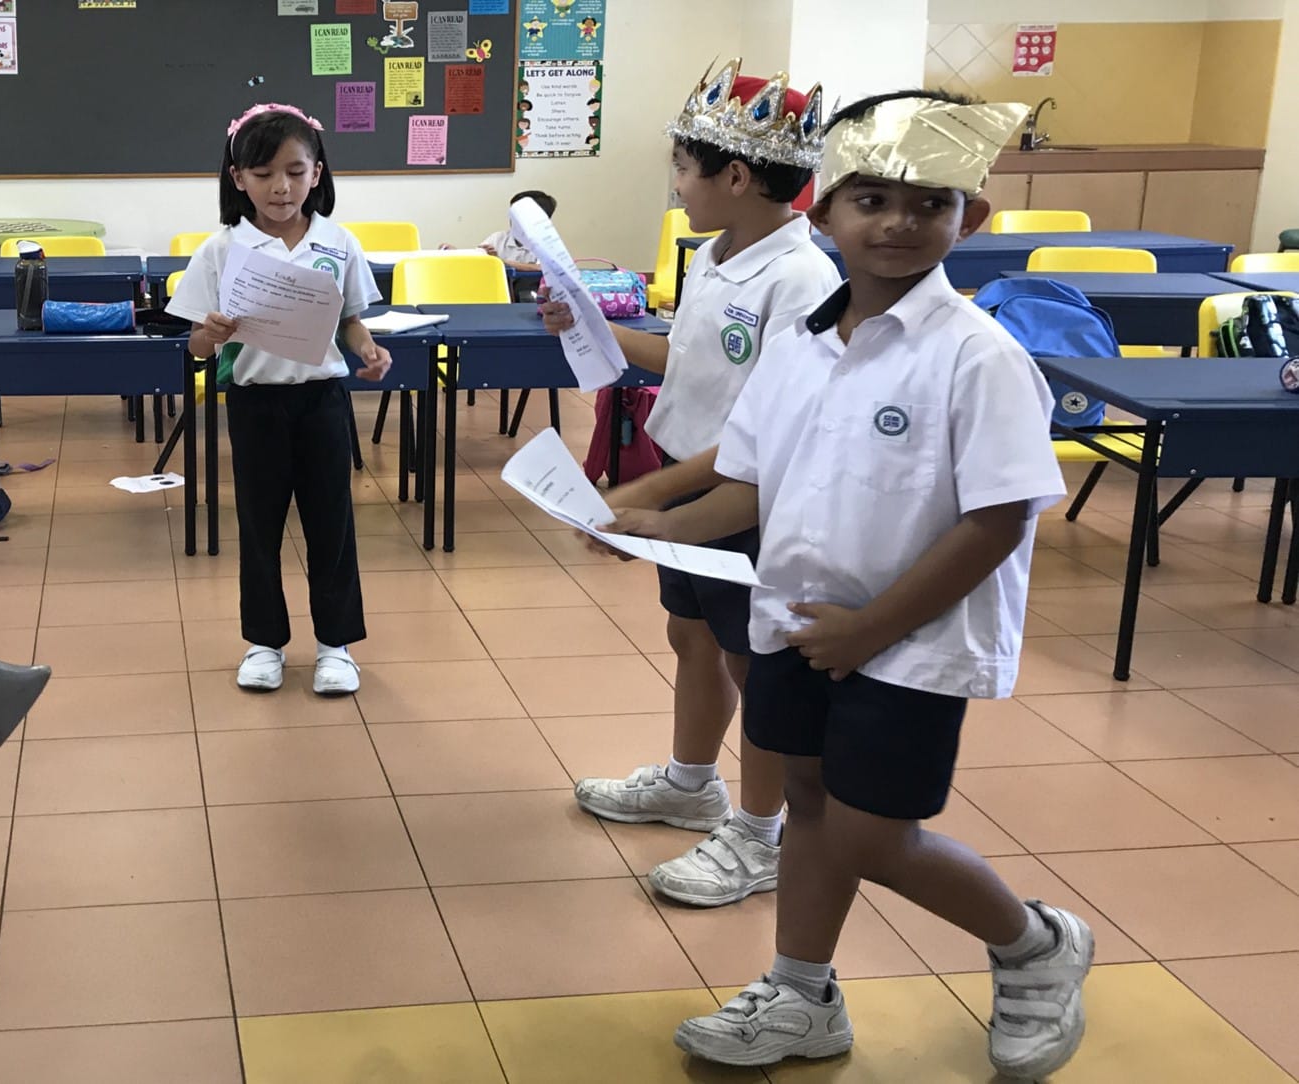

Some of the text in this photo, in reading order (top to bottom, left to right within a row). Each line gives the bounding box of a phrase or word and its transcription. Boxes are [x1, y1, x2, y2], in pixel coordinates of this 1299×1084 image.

[318, 28, 331, 36] CAN
[331, 28, 348, 36] READ
[405, 61, 422, 69] READ
[526, 69, 546, 77] LET'S
[548, 69, 563, 77] GET
[343, 86, 356, 94] CAN
